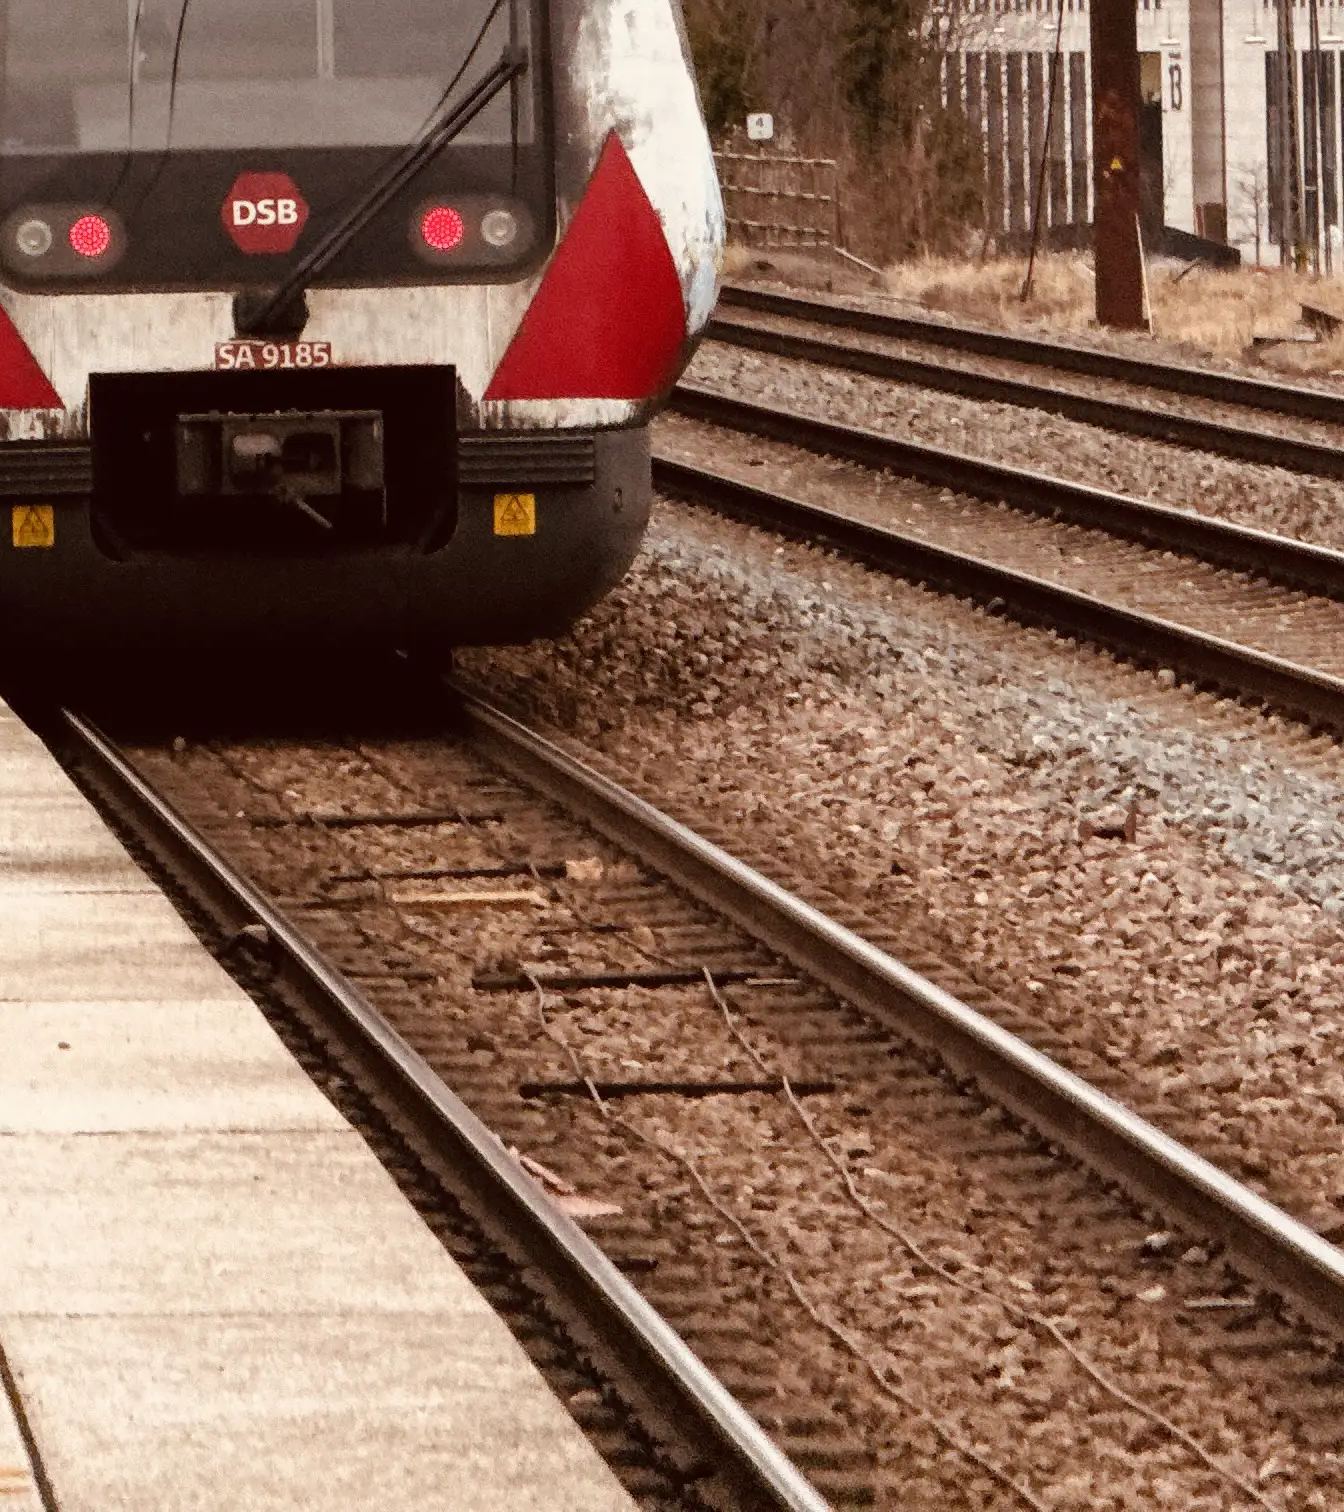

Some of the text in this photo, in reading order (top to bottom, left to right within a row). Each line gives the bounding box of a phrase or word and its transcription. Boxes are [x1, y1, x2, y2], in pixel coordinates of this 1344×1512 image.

[232, 199, 299, 226] DSB
[218, 343, 330, 370] SA 9185
